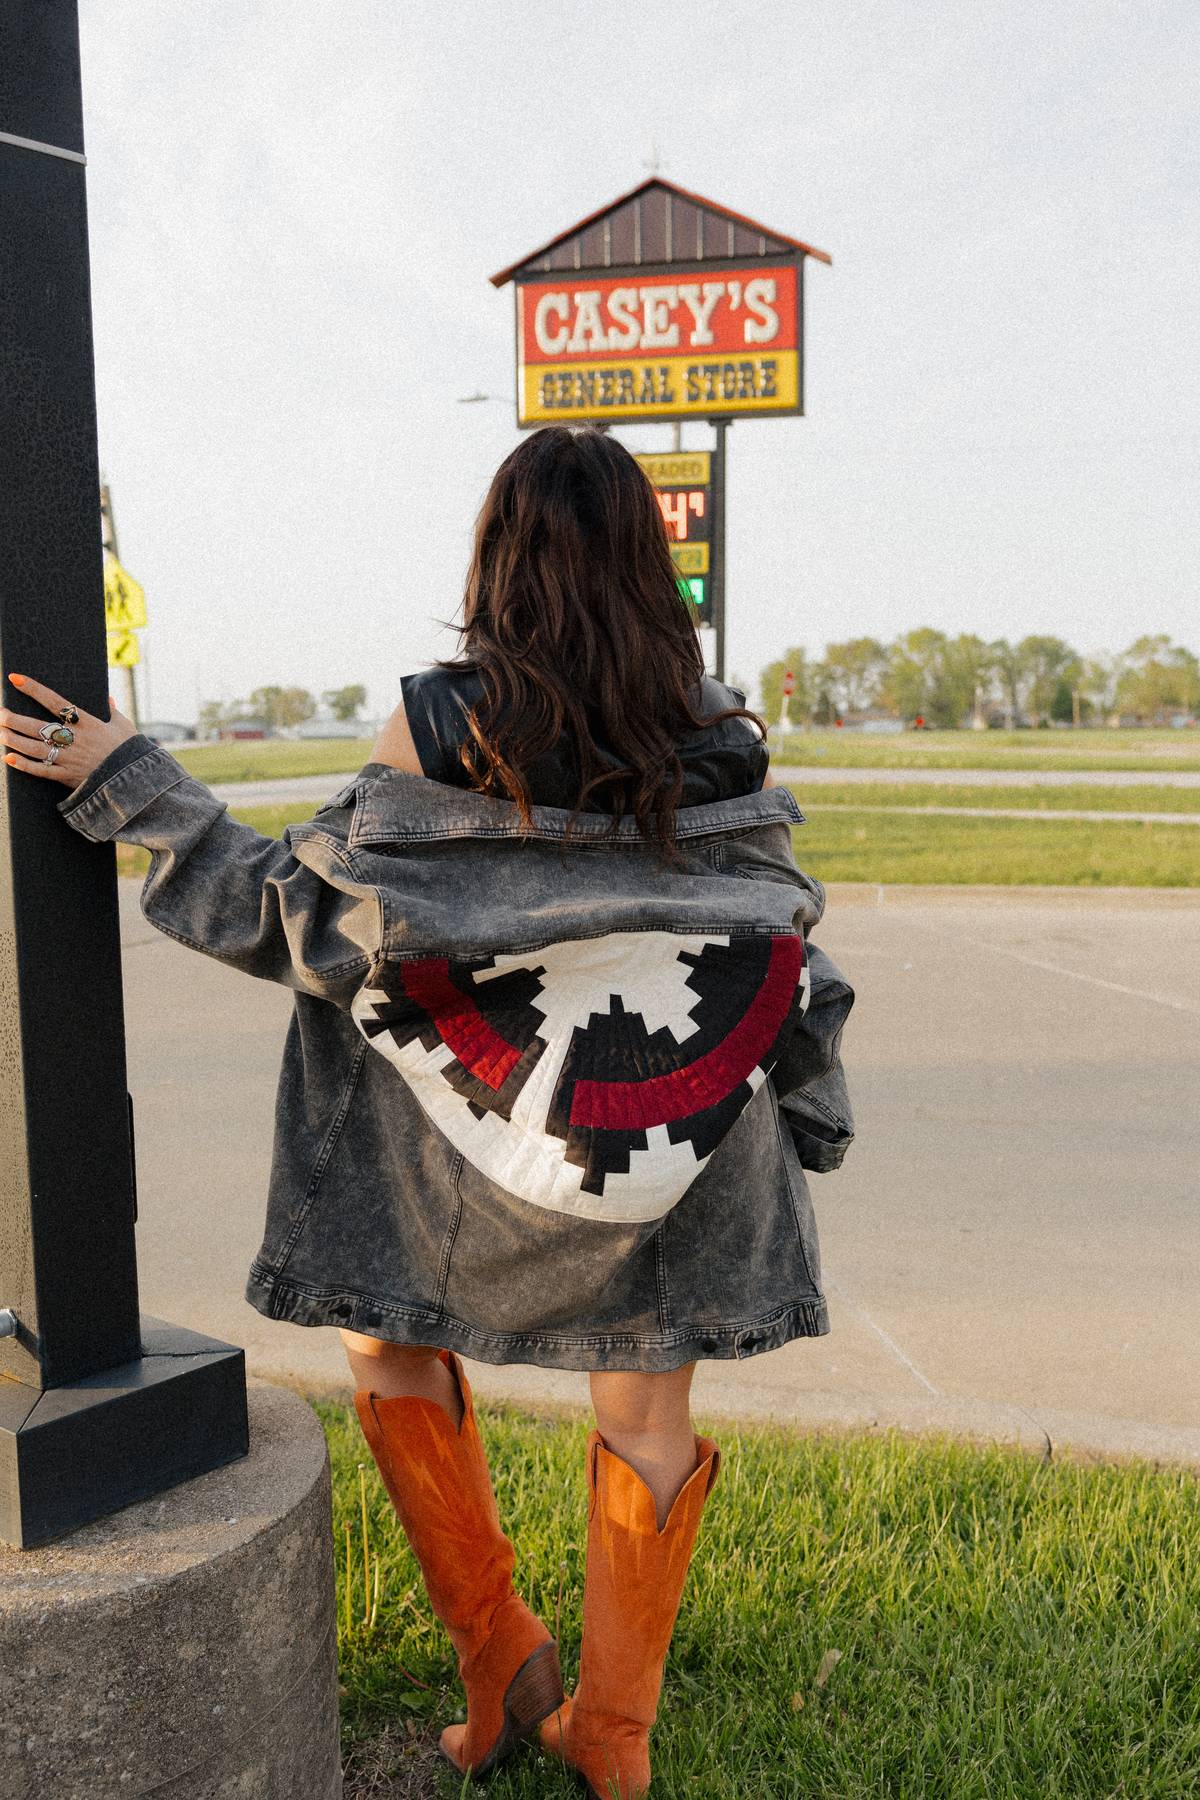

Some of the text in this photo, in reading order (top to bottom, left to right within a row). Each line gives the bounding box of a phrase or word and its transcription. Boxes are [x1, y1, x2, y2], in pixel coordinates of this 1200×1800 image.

[534, 278, 780, 355] CASEY'S
[540, 360, 777, 408] GENERAL STORE
